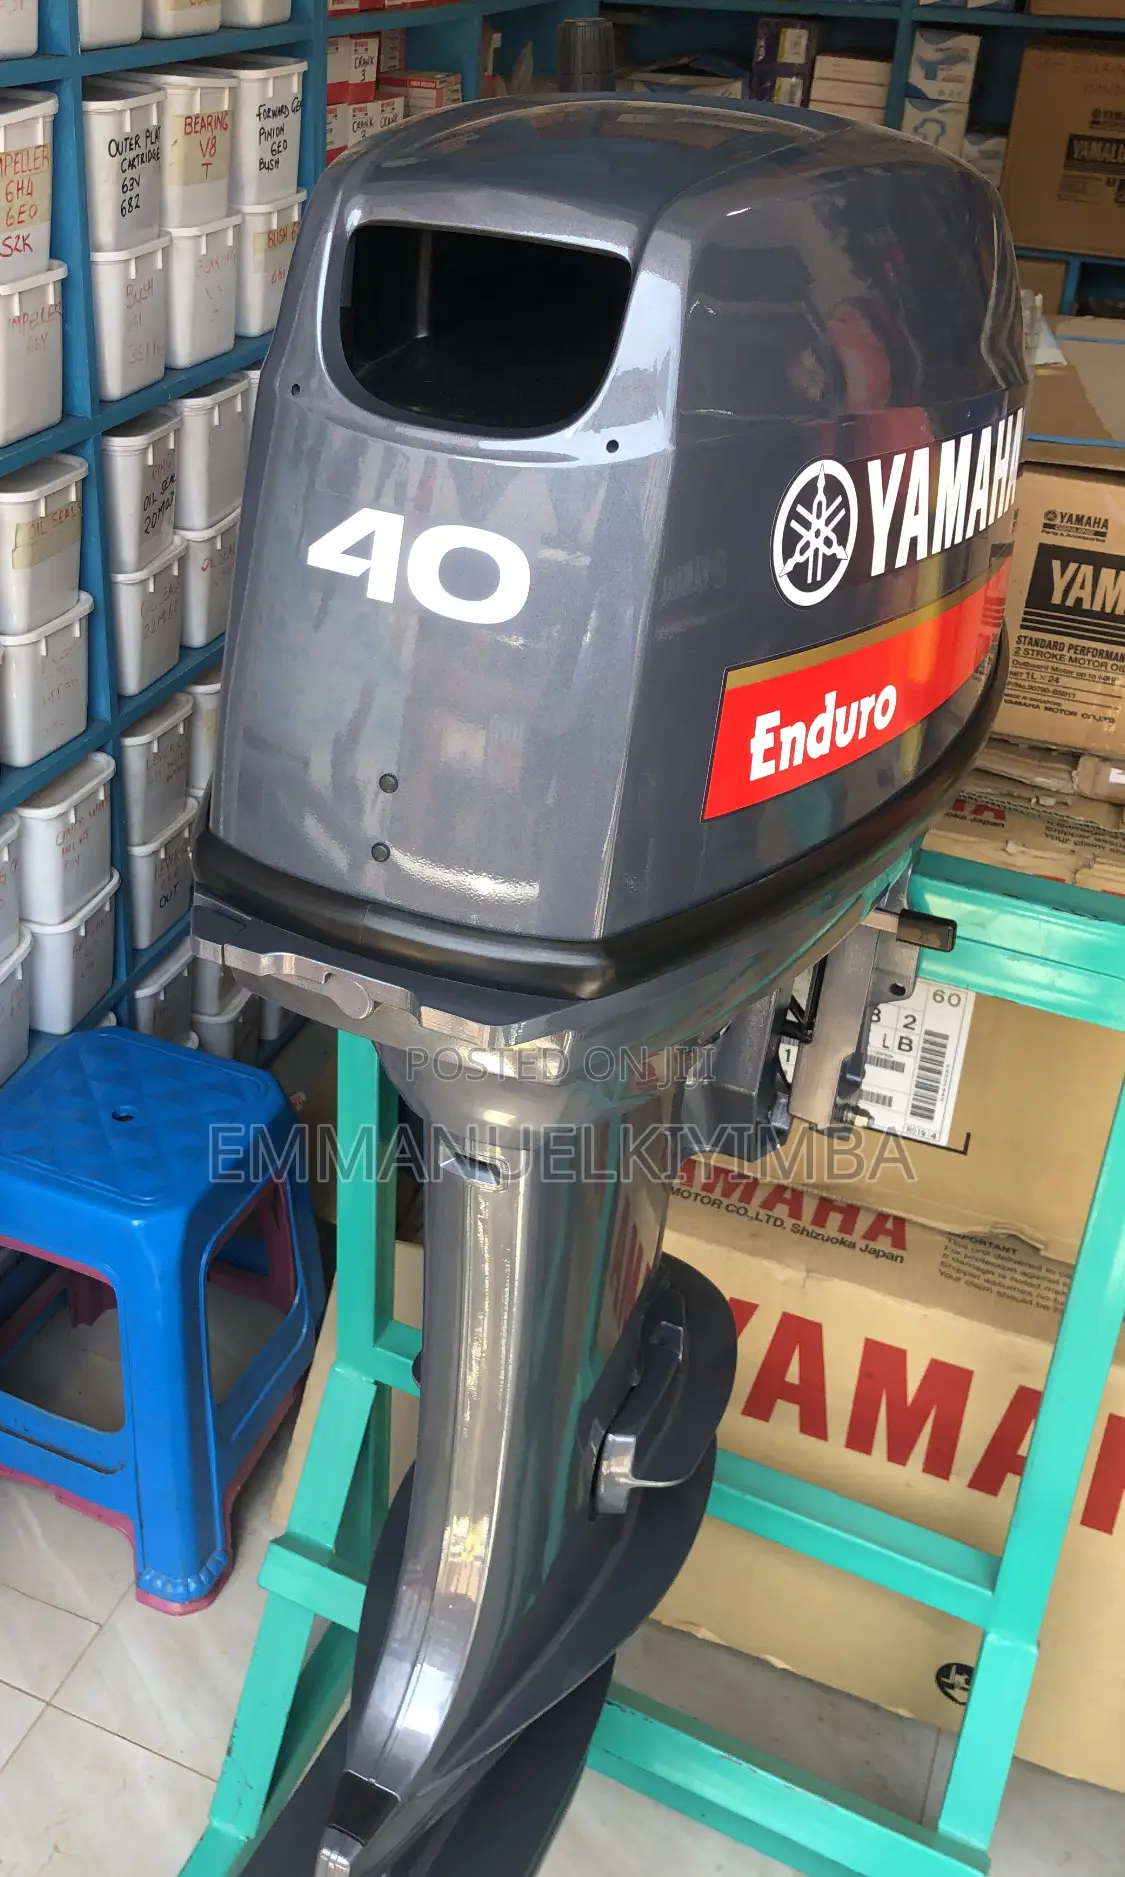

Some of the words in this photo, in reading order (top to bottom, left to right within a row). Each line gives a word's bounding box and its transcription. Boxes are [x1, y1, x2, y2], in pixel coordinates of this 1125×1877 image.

[256, 104, 289, 122] FORWARD
[184, 112, 229, 136] BEARING
[259, 123, 284, 146] PINION
[108, 134, 141, 158] OUTER
[200, 136, 217, 158] V8
[201, 162, 213, 180] T
[259, 158, 280, 172] BUSH
[120, 193, 140, 217] 682
[1060, 511, 1109, 530] YAMAHA
[307, 507, 531, 625] 40
[1015, 635, 1065, 651] STANDARD
[1023, 648, 1066, 662] STROKE
[1068, 656, 1108, 671] MOTOR
[1048, 675, 1060, 684] 24
[1004, 699, 1040, 711] YAMAHA
[1043, 706, 1077, 717] MOTOR
[749, 684, 897, 782] Enduro
[970, 818, 1005, 828] Japan
[160, 881, 180, 908] OUT
[933, 989, 961, 1008] 60
[902, 1014, 917, 1031] 2
[897, 1035, 913, 1052] B
[671, 1186, 723, 1212] MOTOR
[790, 1222, 856, 1250] Shizuoka
[859, 1243, 904, 1264] Japan
